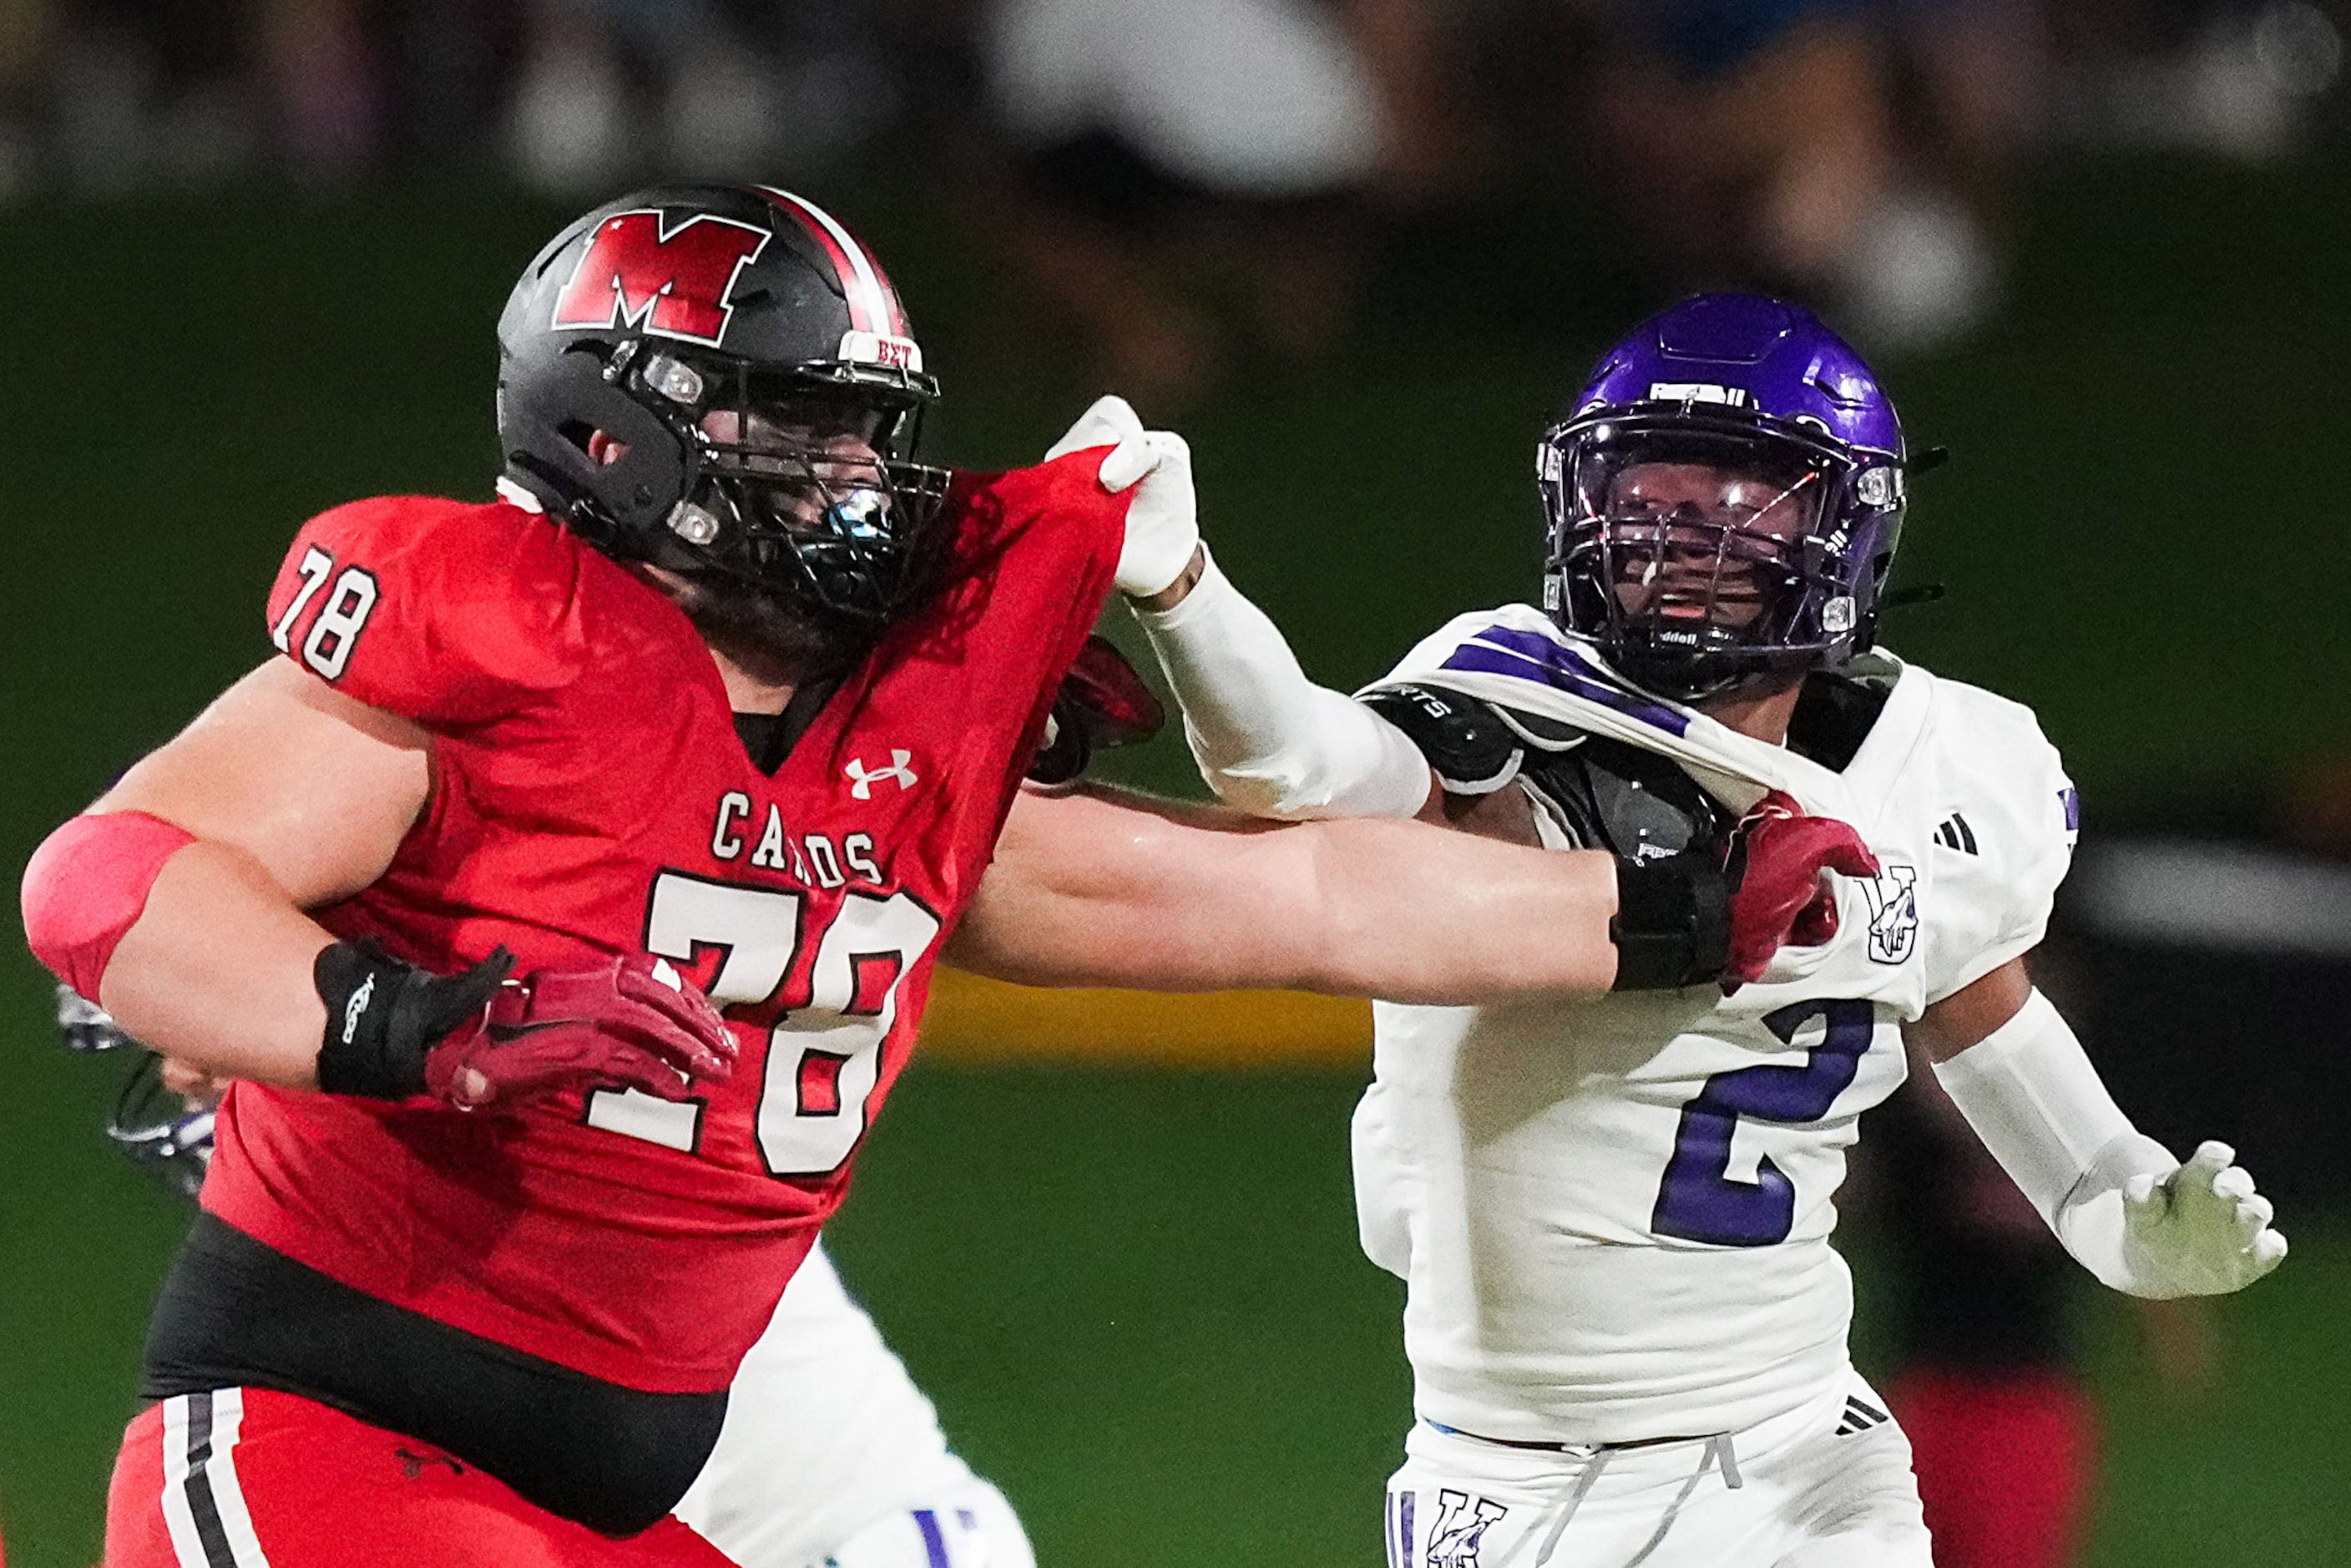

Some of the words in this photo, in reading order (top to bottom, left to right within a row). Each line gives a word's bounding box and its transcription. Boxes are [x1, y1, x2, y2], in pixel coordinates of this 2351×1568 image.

[551, 209, 772, 349] M
[272, 544, 381, 682] 78
[584, 867, 943, 1176] 78
[1651, 997, 1874, 1247] 2
